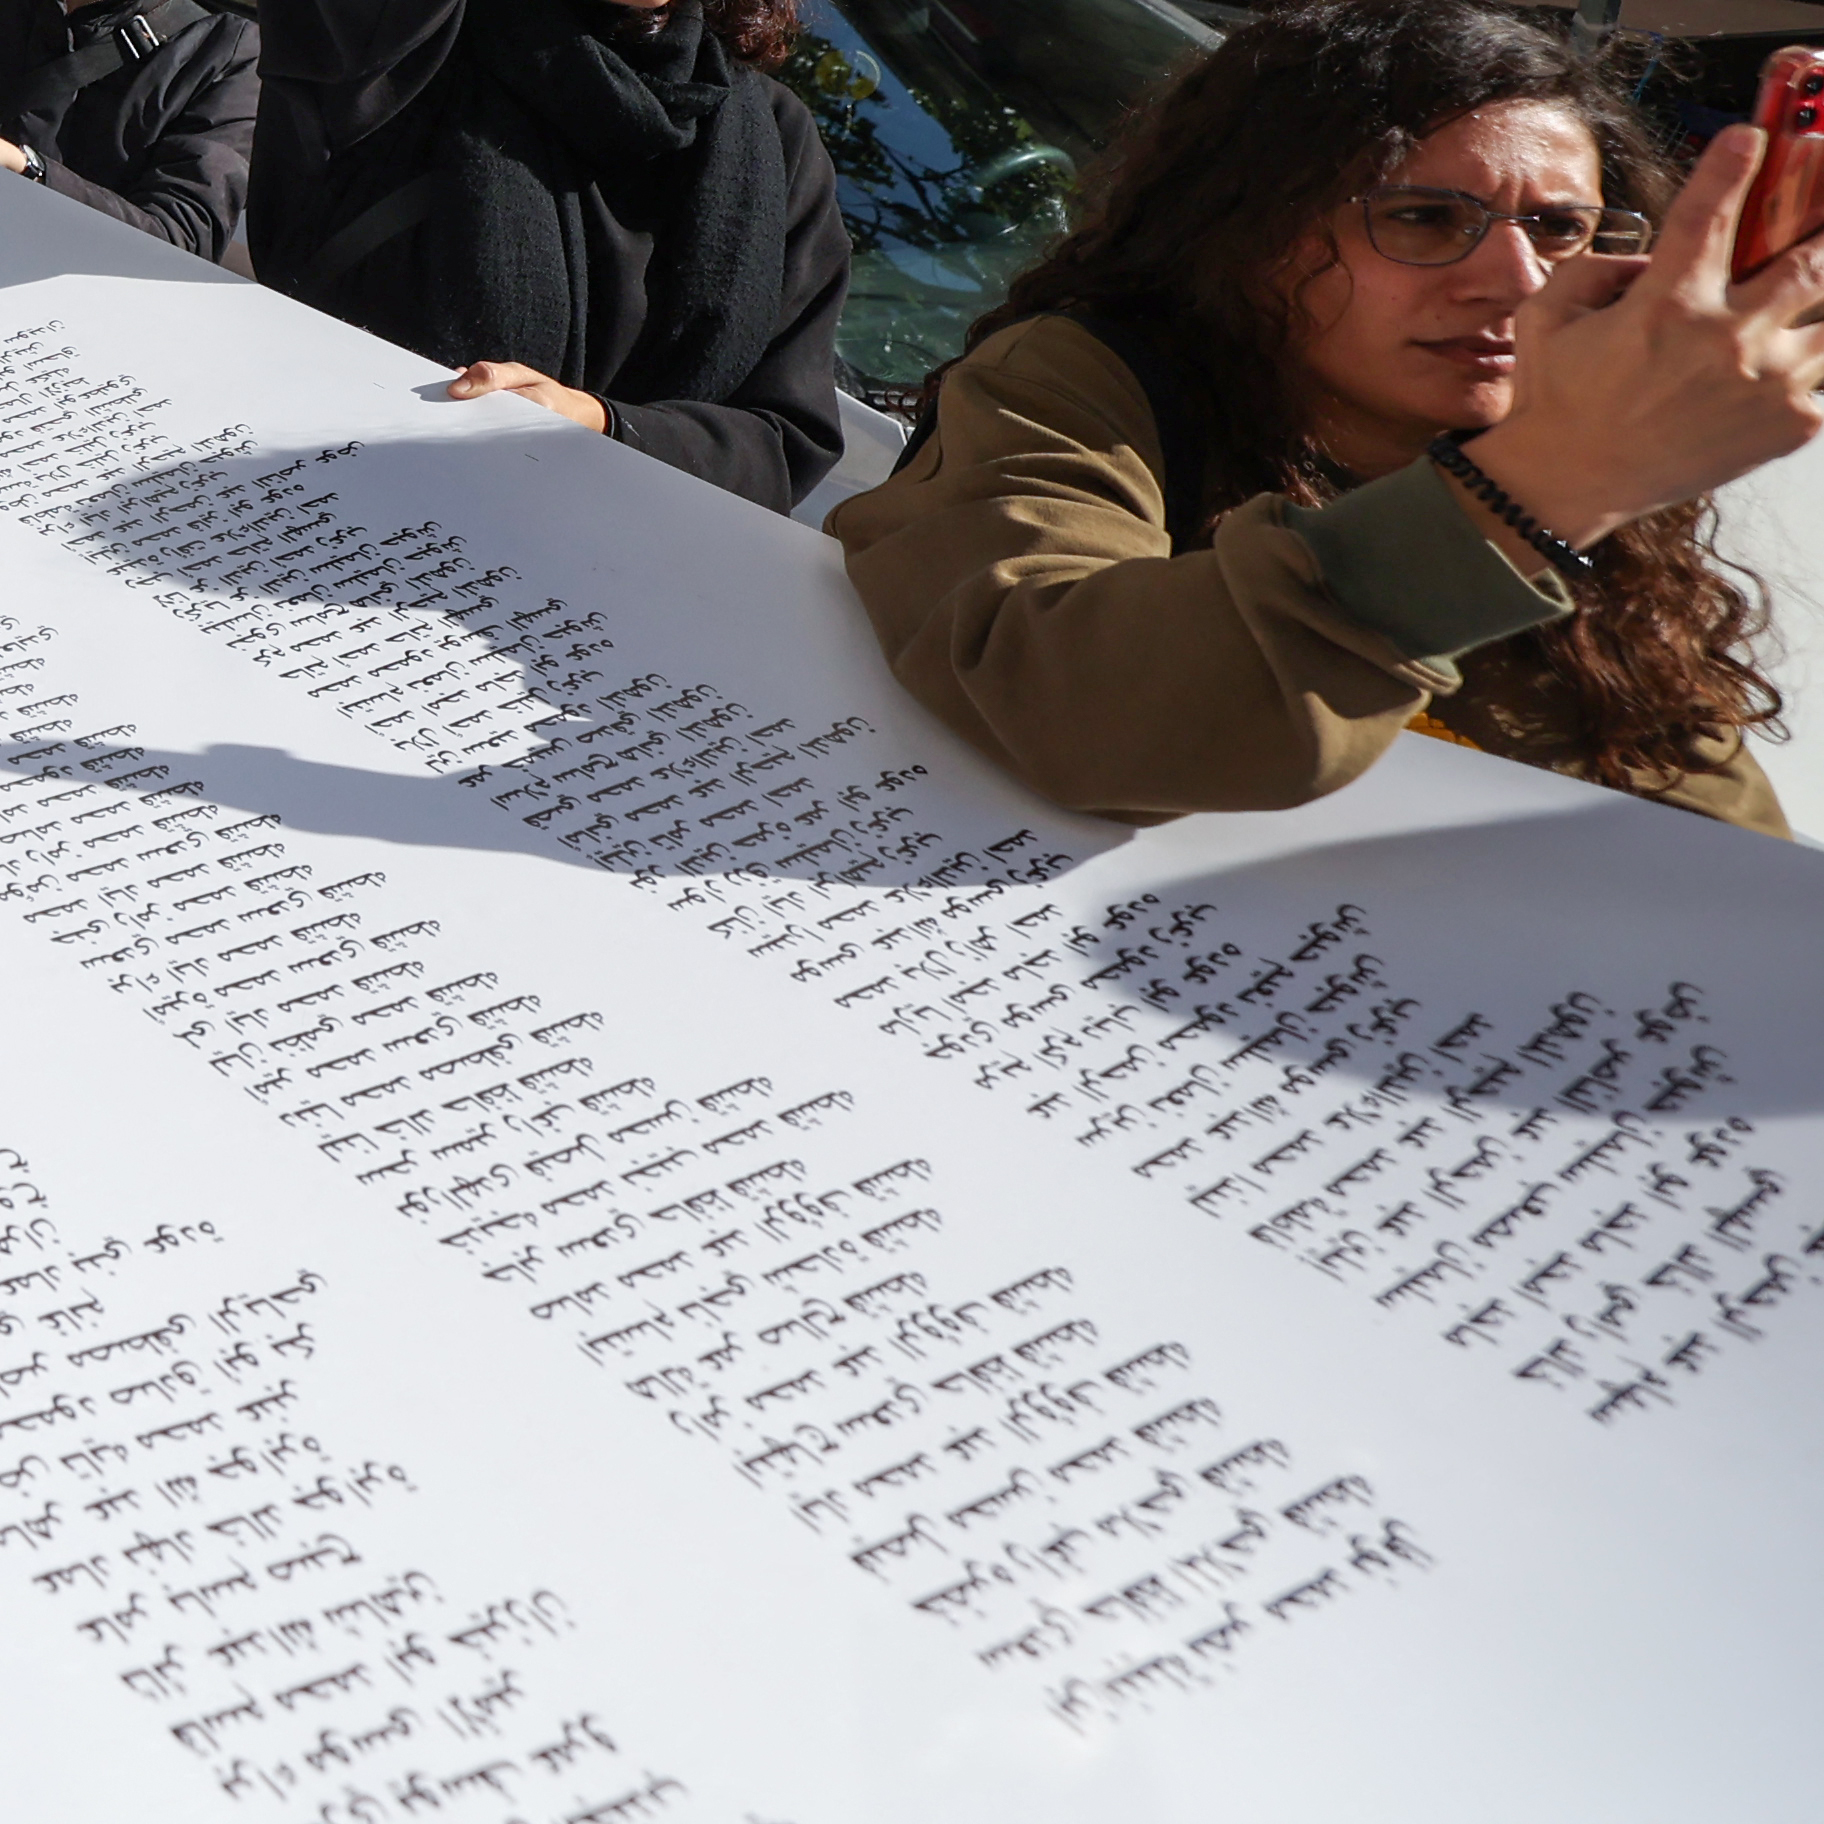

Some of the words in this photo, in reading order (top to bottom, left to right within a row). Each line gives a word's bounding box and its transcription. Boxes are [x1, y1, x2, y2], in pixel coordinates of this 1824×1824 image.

[278, 657, 329, 679] حاتم
[331, 642, 381, 668] أحمد
[384, 618, 434, 643] حاتم
[389, 727, 440, 752] بلال
[441, 709, 493, 737] أحمد
[496, 686, 552, 715] خليل
[545, 669, 605, 697] زعرب
[69, 800, 131, 825] محمد
[137, 780, 205, 809] قشطه
[1441, 1297, 1516, 1348] ماجد
[1509, 1250, 1583, 1310] امجد
[1577, 1201, 1649, 1254] ماجد
[1636, 1161, 1692, 1212] ابو
[1687, 1116, 1754, 1168] عوده
[624, 1365, 709, 1401] هالة
[697, 1331, 742, 1371] عمر
[757, 1298, 846, 1345] صالح
[842, 1272, 926, 1314] قشطه
[1509, 1338, 1586, 1391] خالد
[1563, 1282, 1637, 1342] رامي
[1642, 1242, 1715, 1294] خالد
[84, 1487, 137, 1521] عبد
[156, 1475, 197, 1505] الله
[207, 1431, 329, 1478] جوابرة
[848, 1513, 950, 1582] فيصل
[946, 1467, 1056, 1530] محسن
[1048, 1437, 1118, 1483] محمد
[1132, 1398, 1220, 1446] قشطه
